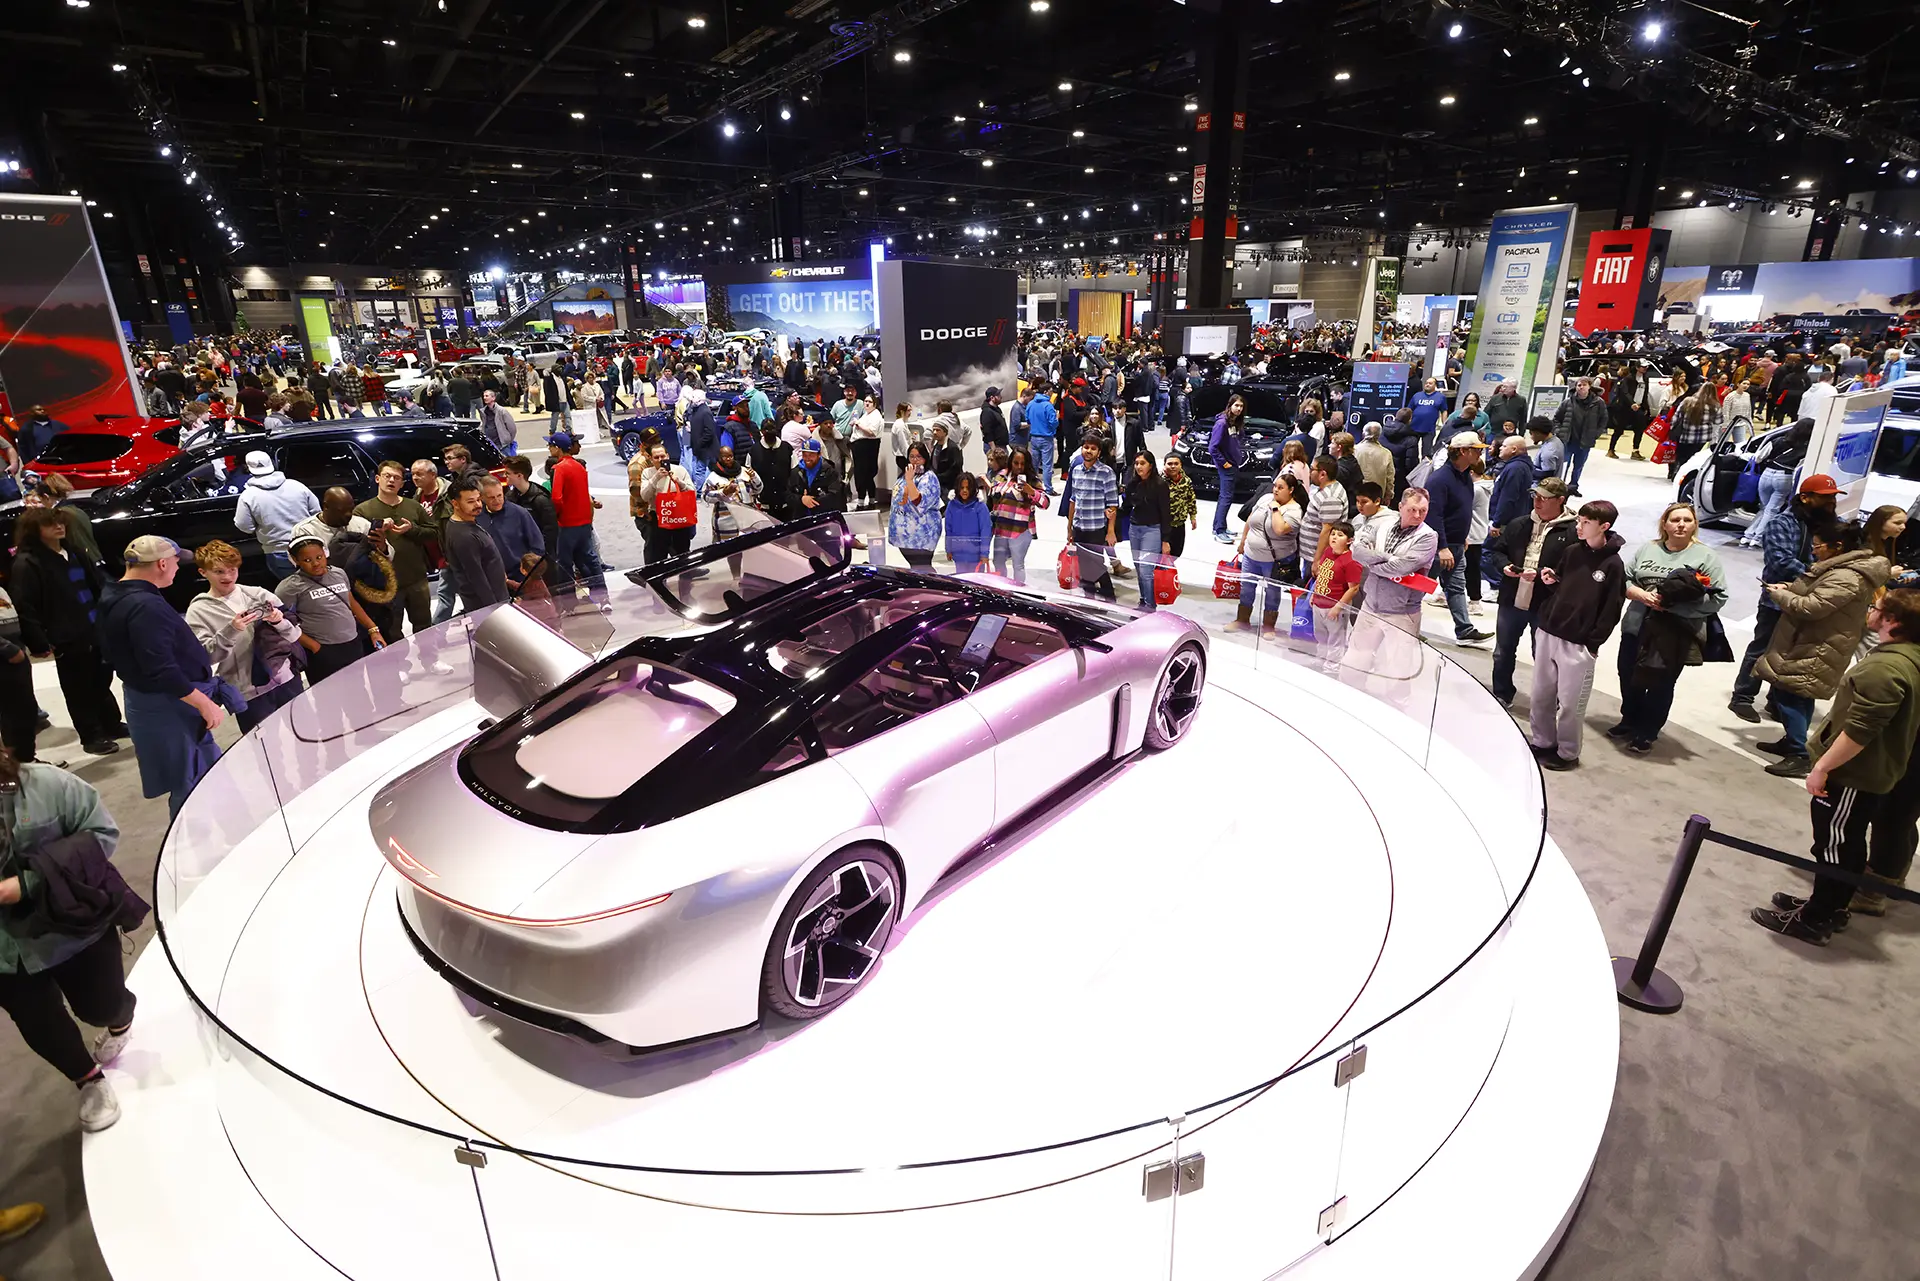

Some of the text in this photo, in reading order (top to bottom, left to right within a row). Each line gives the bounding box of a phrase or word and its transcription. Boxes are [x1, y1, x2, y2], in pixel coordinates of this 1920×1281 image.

[1504, 247, 1540, 256] PACIFICA
[792, 266, 845, 276] CHEVROLET
[1379, 267, 1396, 278] Jeep
[1592, 256, 1634, 284] FIAT
[740, 289, 874, 313] GET OUT THER
[1793, 318, 1831, 328] McIntosh
[920, 326, 988, 341] DODGE
[660, 500, 677, 508] Let's
[660, 508, 672, 516] Go
[661, 516, 687, 524] Places
[1322, 557, 1335, 570] NO
[1222, 582, 1236, 591] Go
[1220, 590, 1241, 598] Plac
[471, 781, 522, 816] HALCYON
